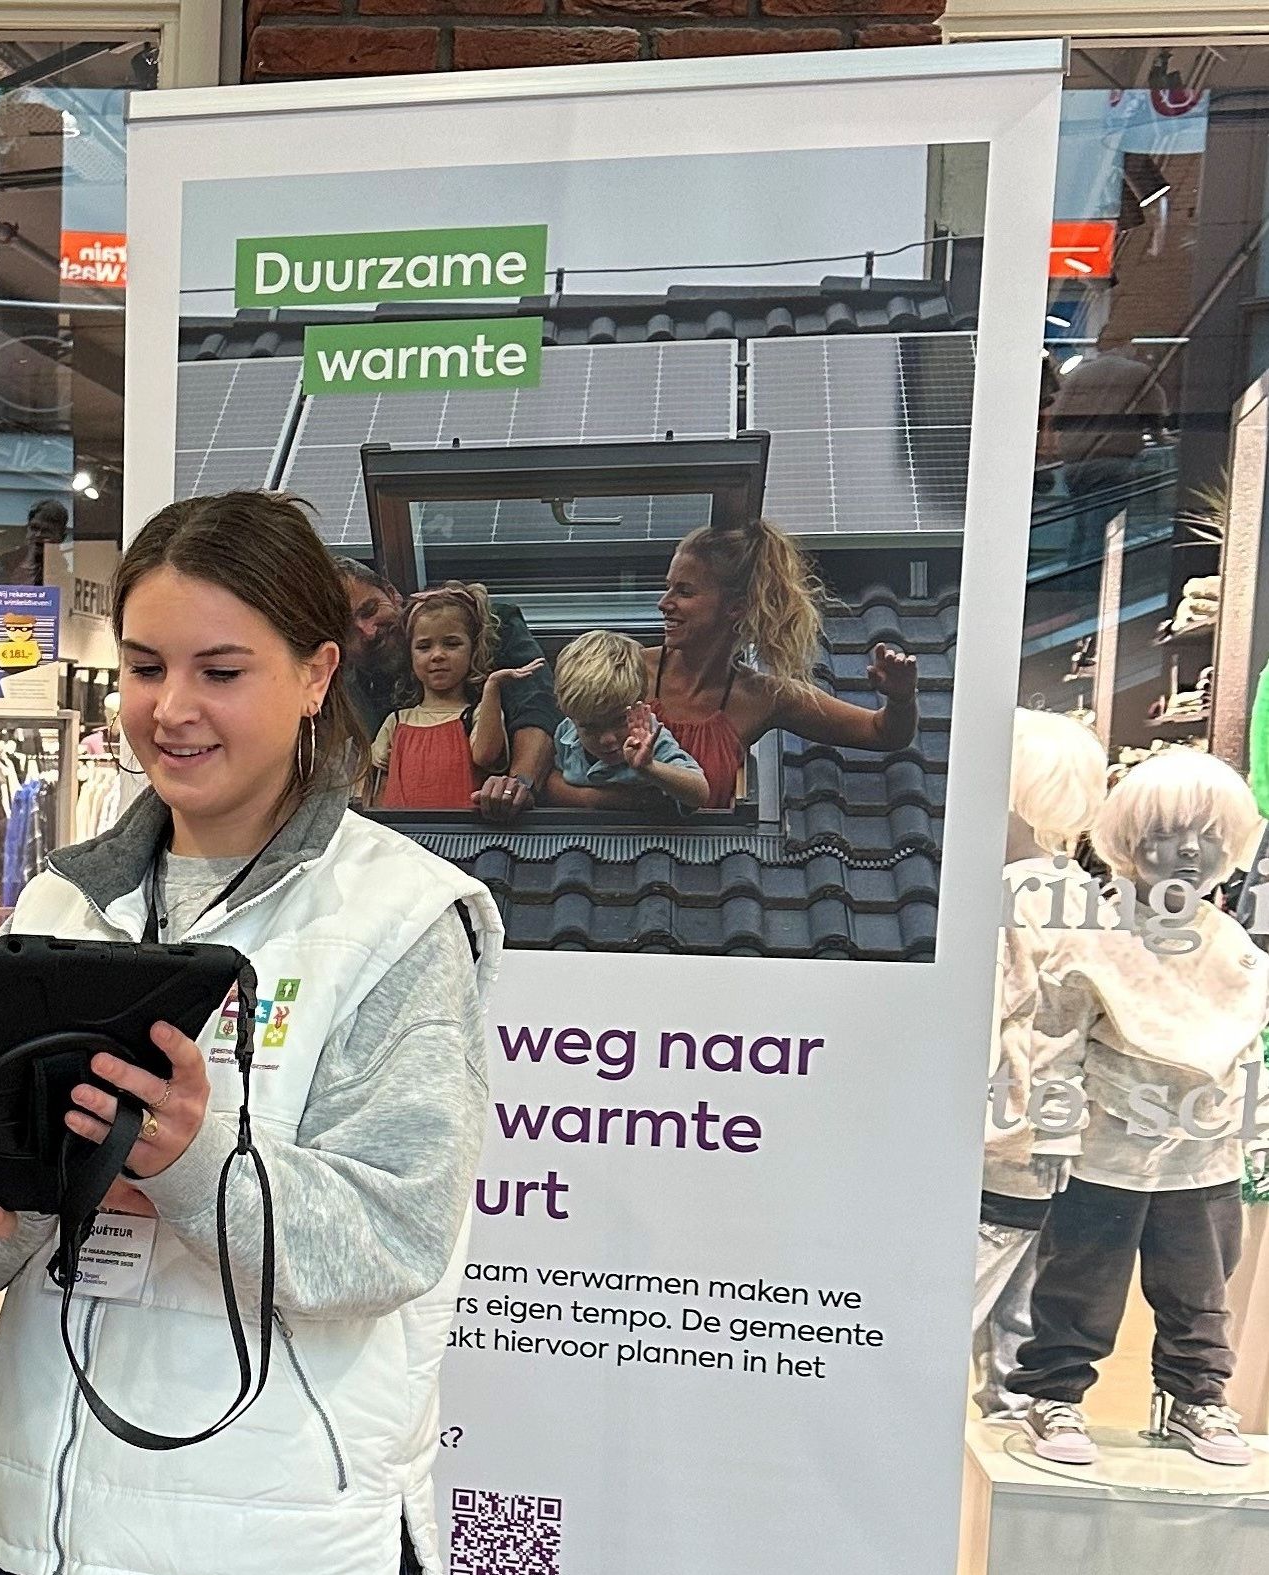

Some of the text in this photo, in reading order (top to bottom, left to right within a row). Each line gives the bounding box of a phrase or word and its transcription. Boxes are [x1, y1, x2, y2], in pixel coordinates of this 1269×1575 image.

[254, 251, 528, 295] Duurzame
[317, 334, 527, 382] warmte
[497, 1025, 825, 1081] weg naar
[988, 1061, 1082, 1134] to
[494, 1100, 763, 1153] warmte
[474, 1171, 569, 1220] urt
[464, 1263, 862, 1309] aam verwarmen maken we
[456, 1295, 884, 1347] rs eigen tempo. De gemeente
[494, 1328, 609, 1359] hiervoor
[617, 1340, 734, 1370] plannen
[743, 1349, 766, 1373] in
[777, 1352, 826, 1379] het
